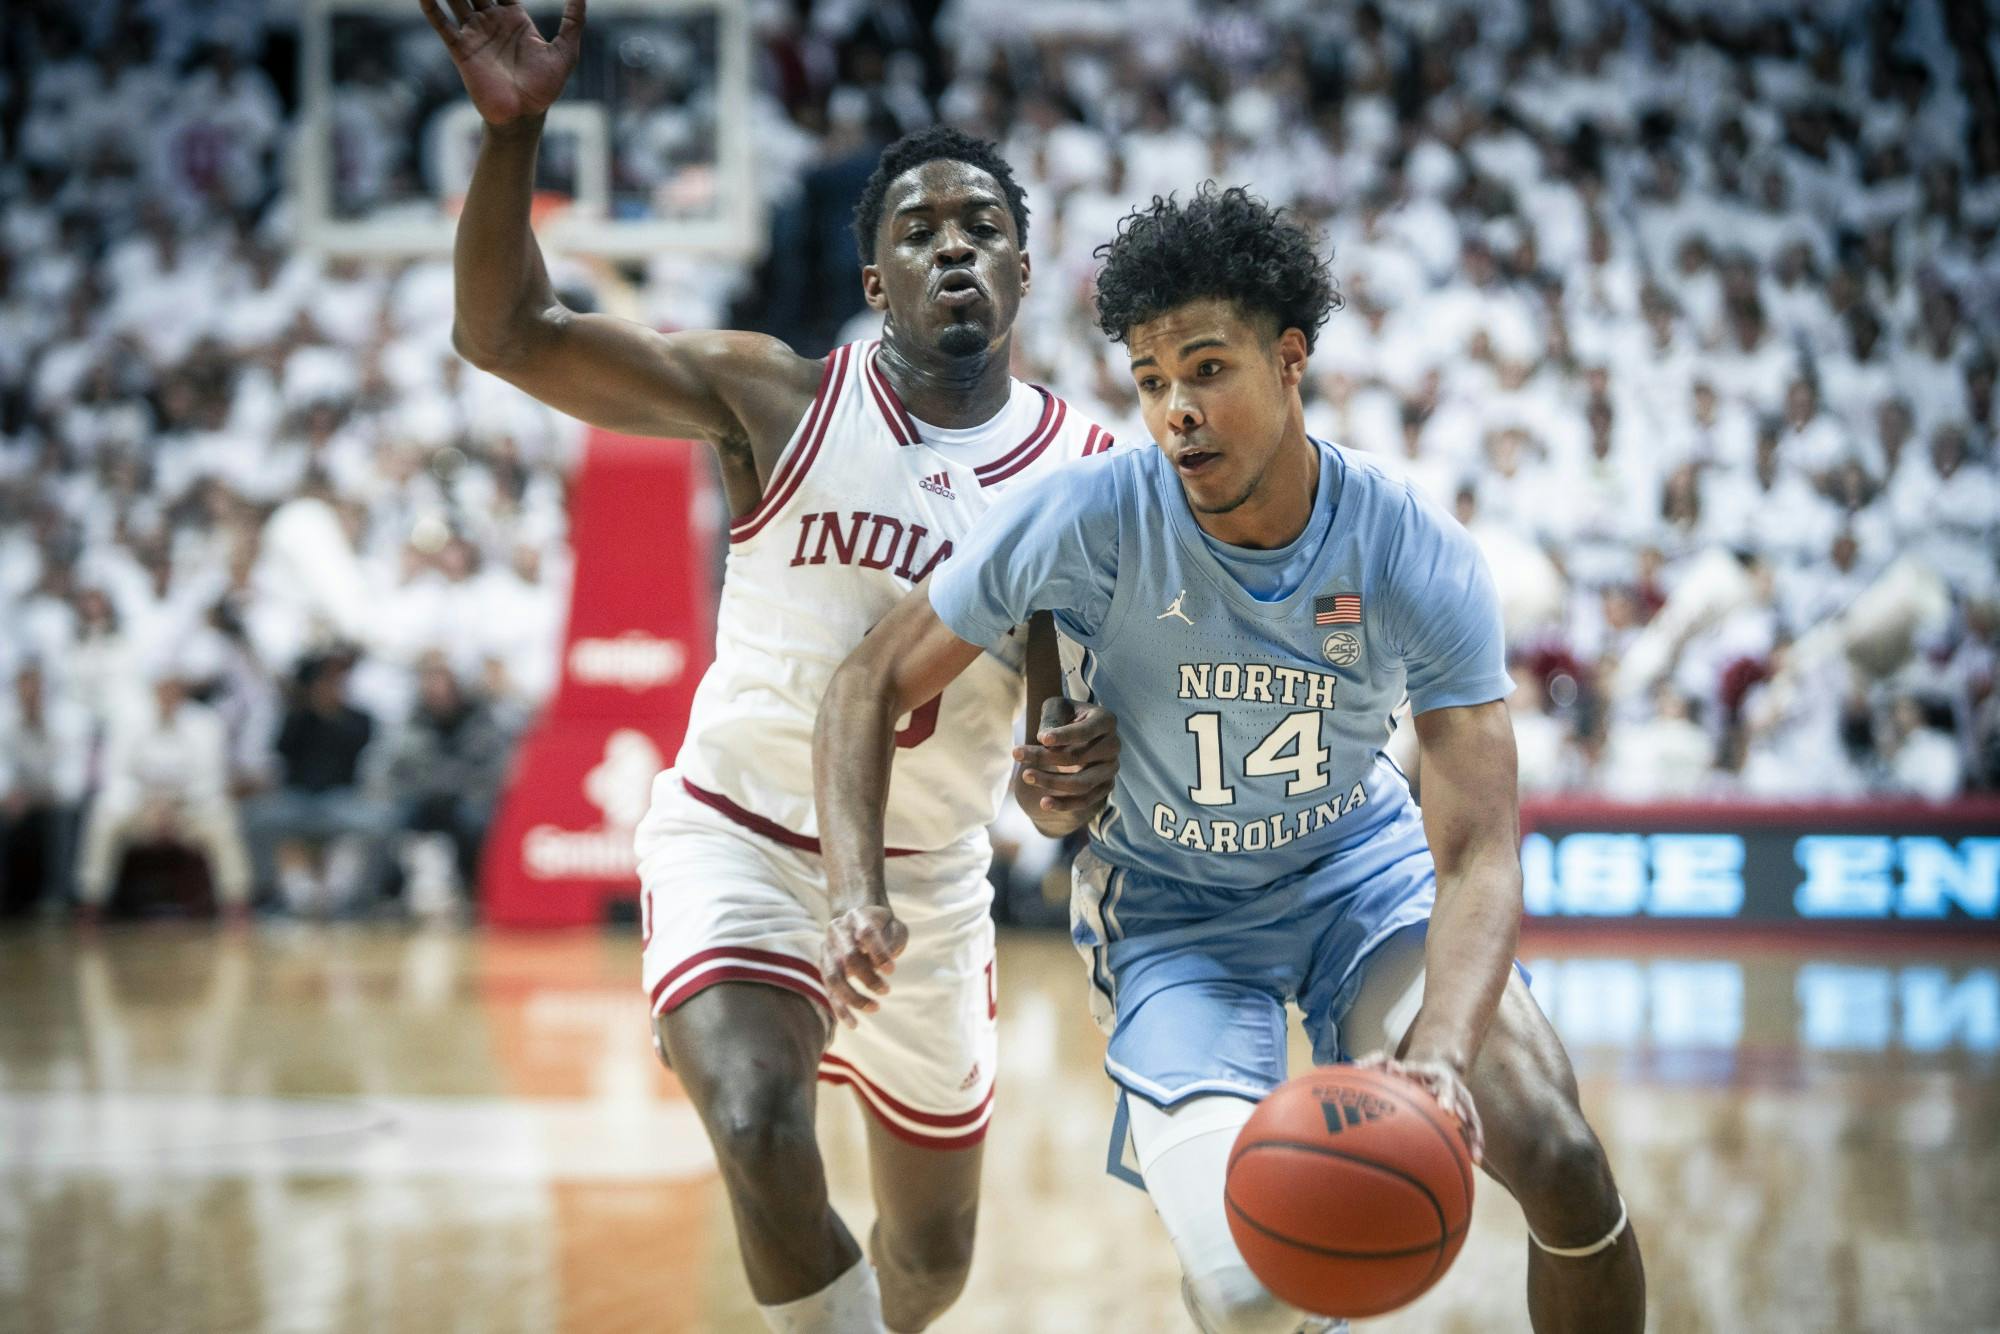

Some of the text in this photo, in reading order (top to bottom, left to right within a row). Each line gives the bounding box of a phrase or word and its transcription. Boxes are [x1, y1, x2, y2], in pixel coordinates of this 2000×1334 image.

[919, 480, 956, 500] adidas
[1177, 663, 1337, 709] NORTH
[1185, 710, 1332, 806] 14
[1152, 781, 1368, 853] CAROLINA
